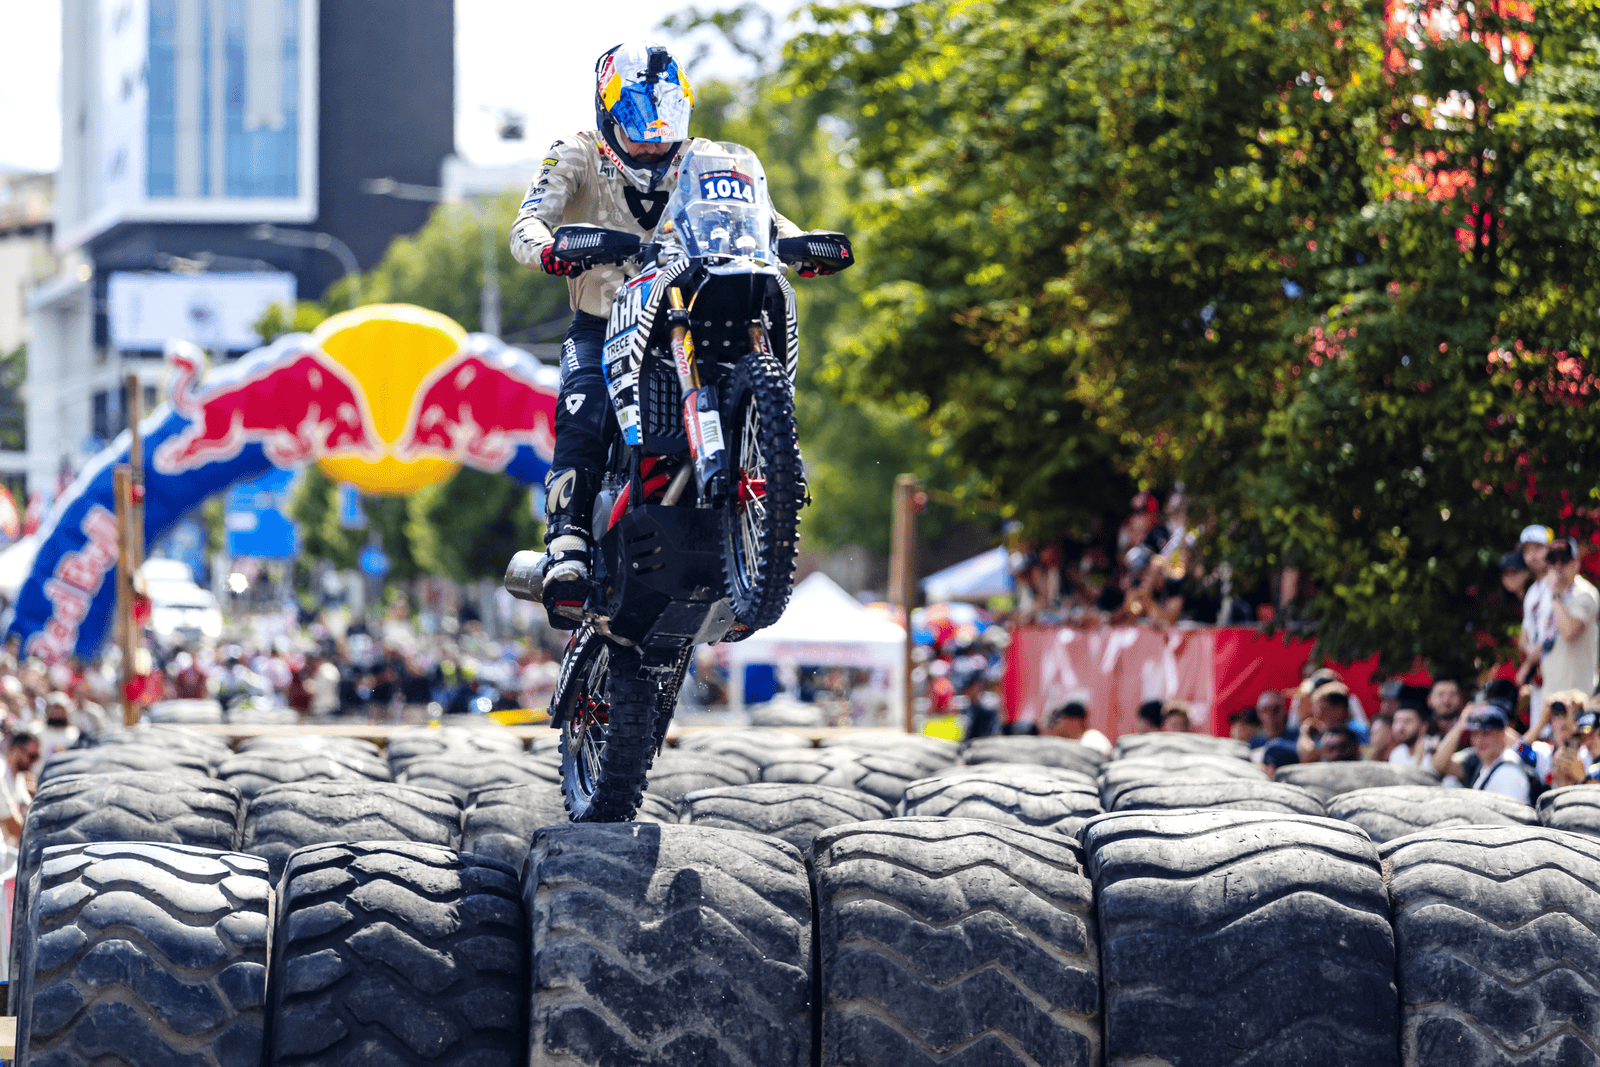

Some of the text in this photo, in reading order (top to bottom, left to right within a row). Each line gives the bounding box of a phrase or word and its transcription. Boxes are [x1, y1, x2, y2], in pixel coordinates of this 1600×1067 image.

[644, 129, 675, 139] Red Bull
[704, 179, 754, 203] 1014
[606, 334, 630, 359] TRECE
